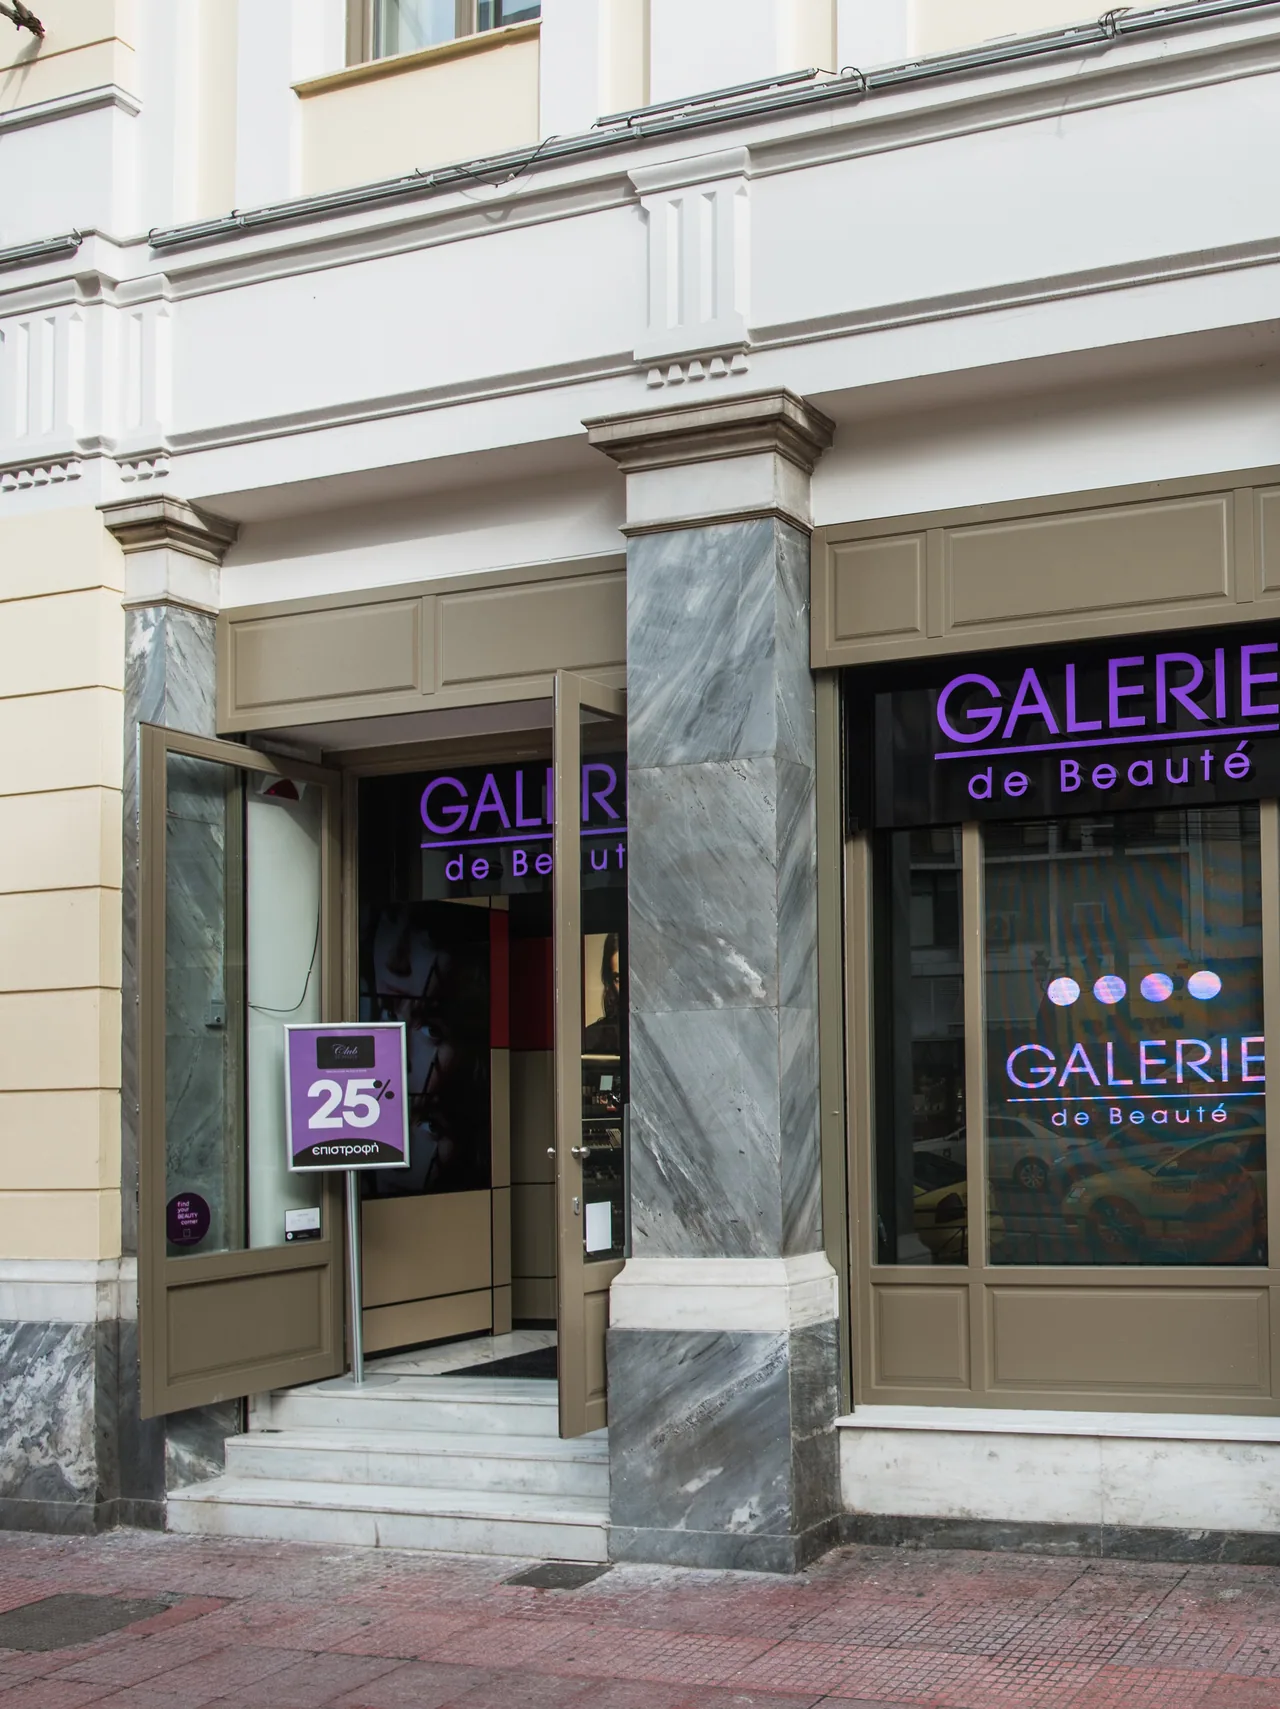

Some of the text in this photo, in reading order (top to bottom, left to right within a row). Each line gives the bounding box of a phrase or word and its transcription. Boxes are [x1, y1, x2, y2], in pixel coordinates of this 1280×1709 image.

[936, 642, 1280, 744] GALERIE
[967, 739, 1251, 800] de Beauté
[420, 763, 628, 835] GALR
[445, 843, 626, 881] de Beut
[1006, 1036, 1266, 1089] GALERIE
[1051, 1102, 1228, 1126] de Beauté
[311, 1142, 379, 1156] επιστροφή
